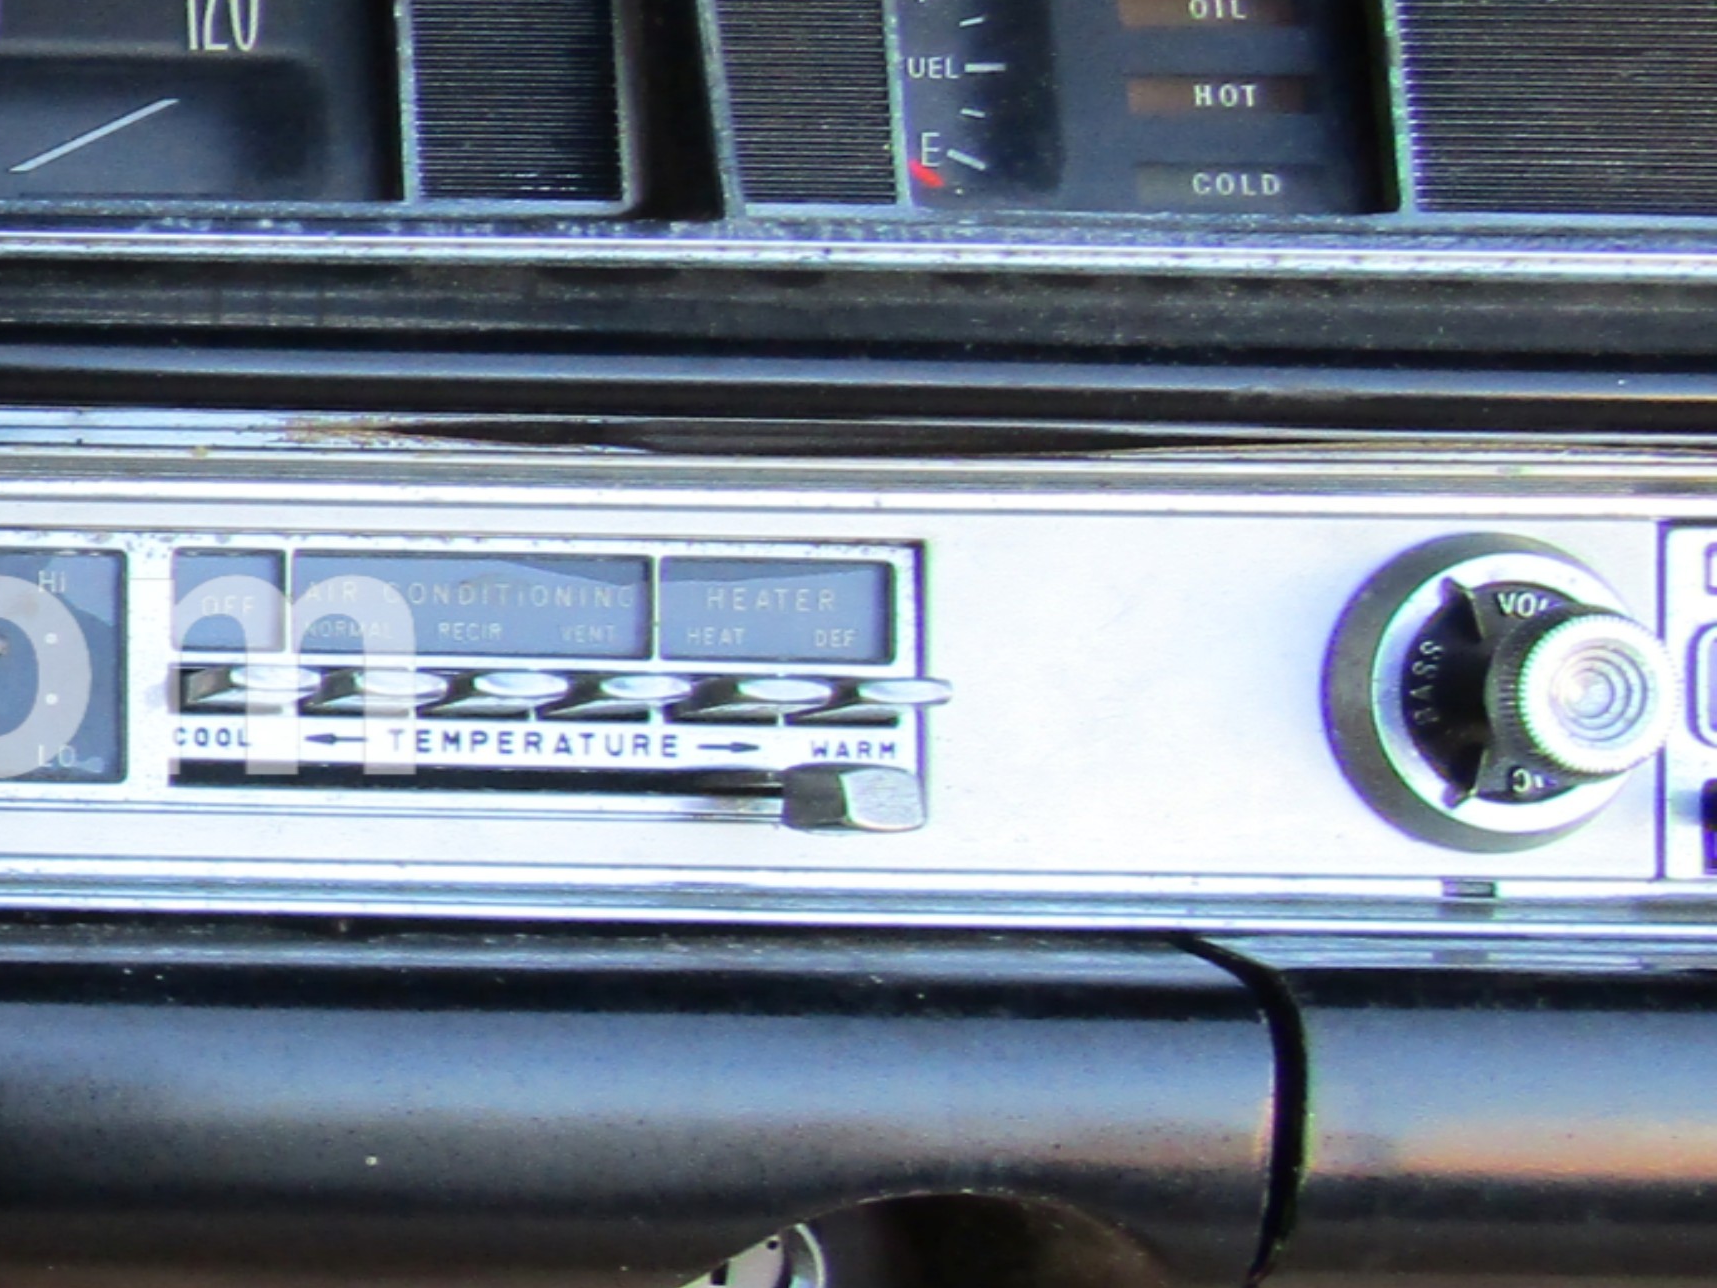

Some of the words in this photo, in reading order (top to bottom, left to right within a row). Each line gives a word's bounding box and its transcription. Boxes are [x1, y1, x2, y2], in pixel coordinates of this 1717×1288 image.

[1193, 83, 1259, 108] HOT
[920, 131, 942, 168] E
[1191, 172, 1283, 197] COLD
[37, 569, 66, 594] HI
[200, 594, 256, 616] OFF
[305, 581, 358, 604] AIR
[383, 581, 634, 608] CONDITIONING
[706, 586, 837, 611] HEATER
[304, 621, 394, 641] NORMAL
[437, 622, 503, 641] RECIR
[562, 624, 617, 644] VENT
[687, 627, 746, 647] HEAT
[813, 628, 857, 648] DEF
[1409, 640, 1445, 726] BASS
[171, 725, 253, 748] COOL
[388, 727, 680, 759] TEMPERATURE
[809, 738, 898, 761] WARM
[37, 744, 78, 768] LO
